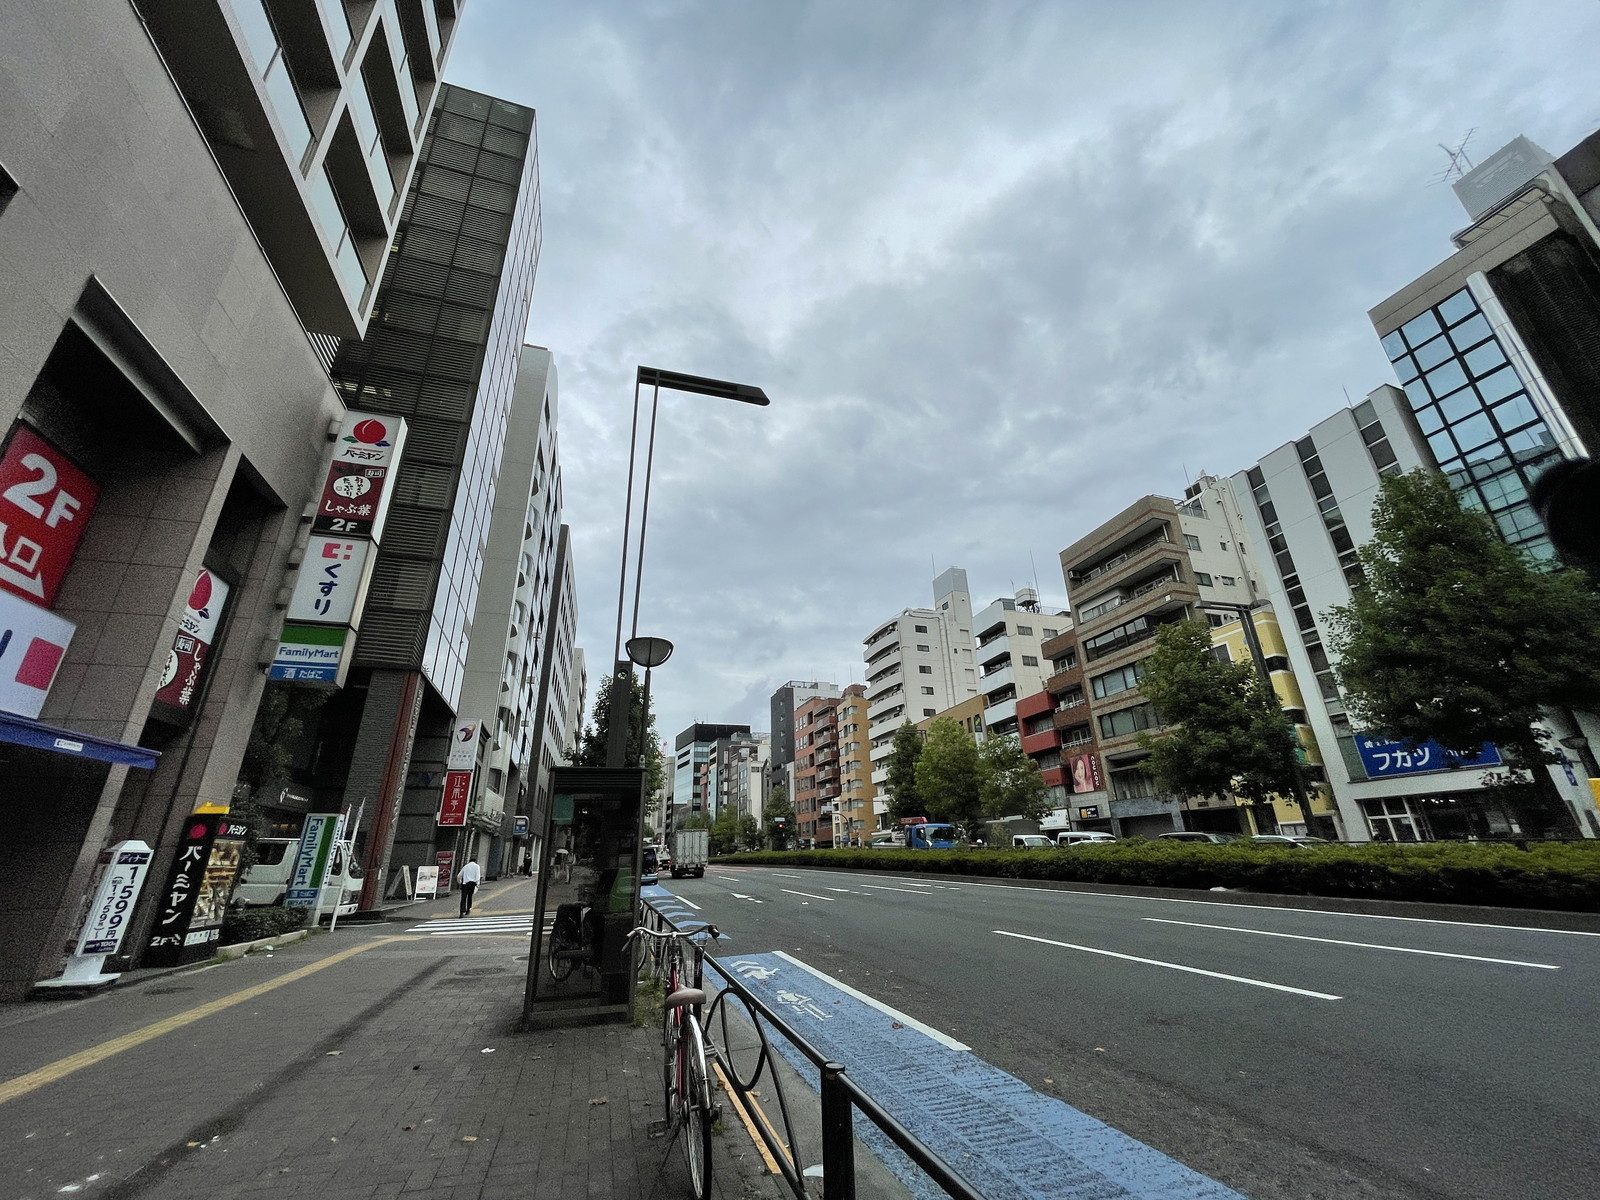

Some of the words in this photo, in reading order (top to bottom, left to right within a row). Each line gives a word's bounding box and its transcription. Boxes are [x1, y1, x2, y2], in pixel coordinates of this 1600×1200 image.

[341, 449, 385, 461] バーミヤン
[2, 452, 82, 529] 2F
[325, 500, 372, 516] しゃぶ葉
[329, 518, 358, 533] 2F
[314, 562, 342, 616] くすり
[278, 645, 340, 659] FamilyMart
[178, 642, 202, 705] しゃぶ葉
[283, 668, 296, 679] 酒
[298, 669, 324, 680] たばこ
[1372, 747, 1430, 771] フカツ
[119, 853, 149, 863] ディナー
[295, 817, 324, 886] FamilyMart
[162, 846, 203, 925] バーミヤン
[105, 866, 139, 939] 1,599円
[150, 936, 168, 947] 2F
